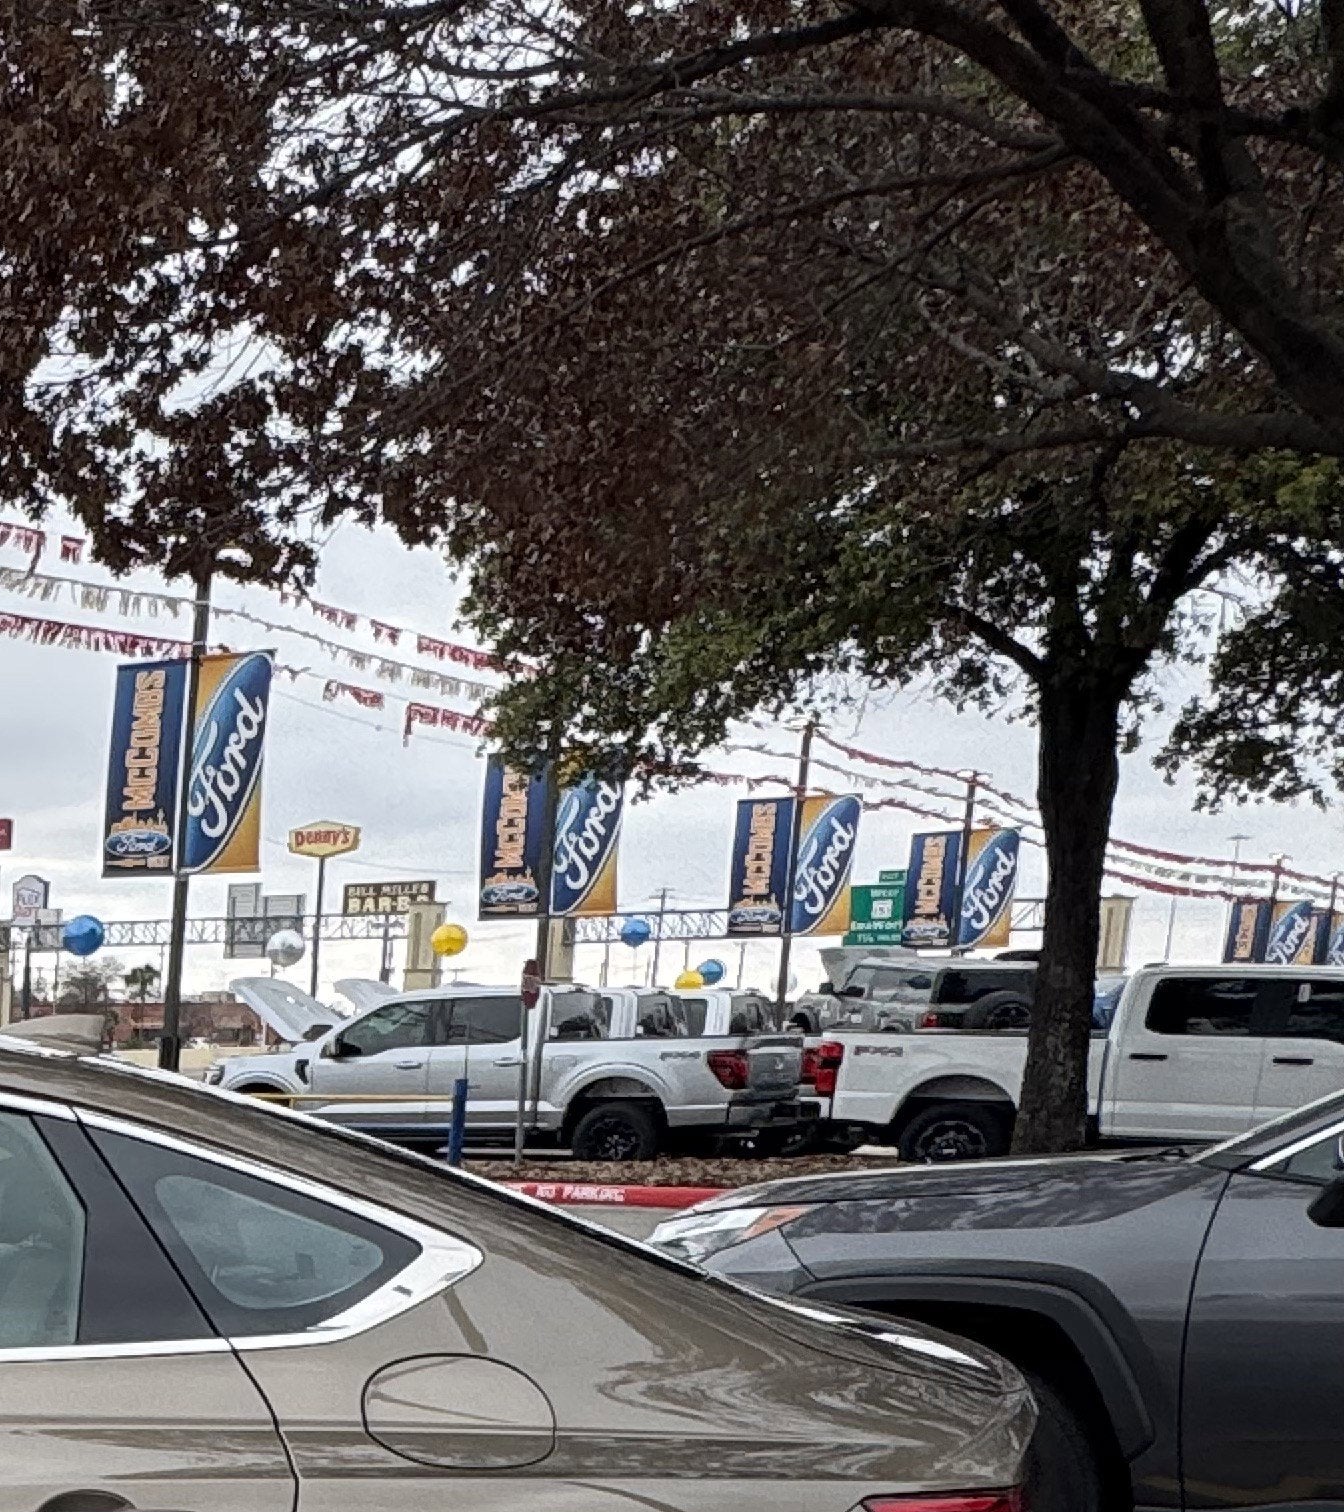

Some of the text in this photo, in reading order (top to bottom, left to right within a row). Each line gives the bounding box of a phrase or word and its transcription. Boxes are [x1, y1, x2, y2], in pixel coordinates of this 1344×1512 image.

[188, 687, 265, 838] Ford
[116, 836, 158, 853] Ford
[294, 827, 351, 847] Denny's
[553, 781, 622, 890] Ford
[794, 817, 854, 915] Ford
[348, 886, 377, 897] BILL
[961, 847, 1016, 930] Ford
[1265, 913, 1310, 965] Ford
